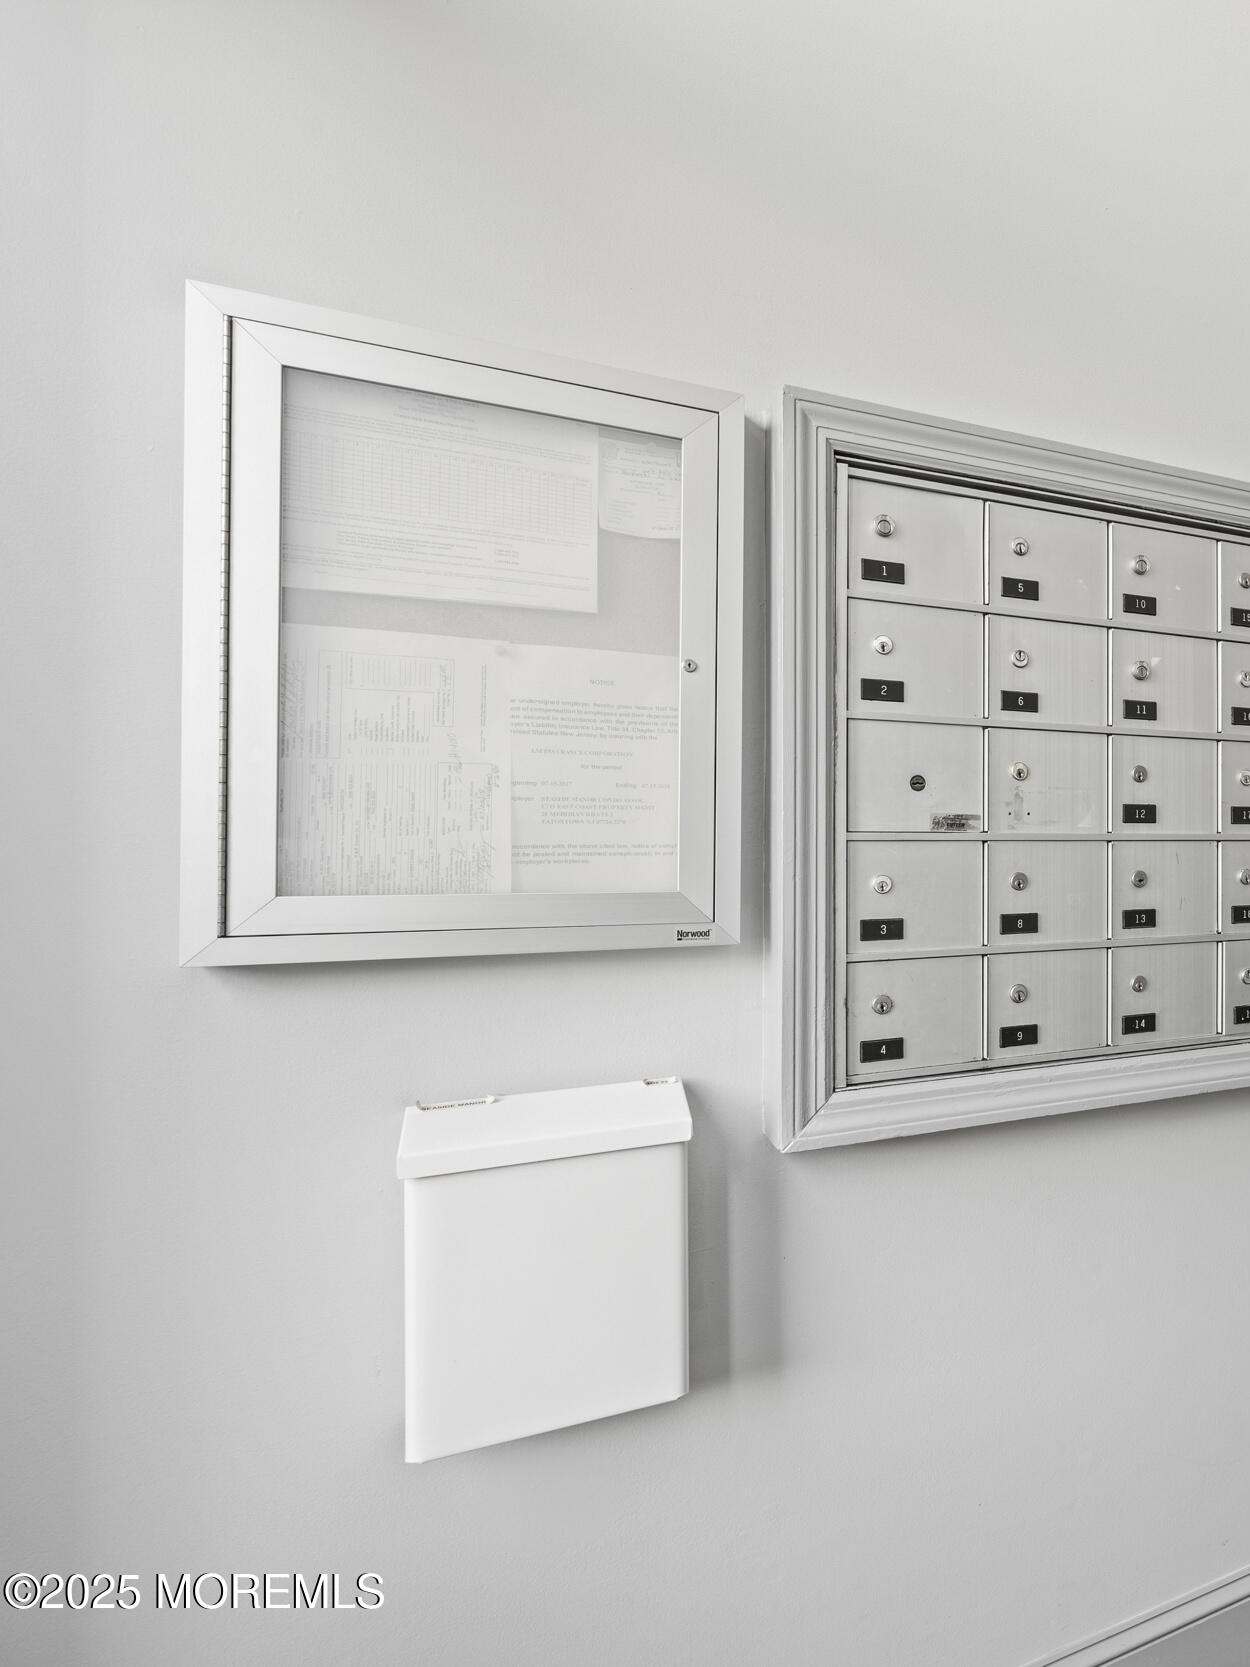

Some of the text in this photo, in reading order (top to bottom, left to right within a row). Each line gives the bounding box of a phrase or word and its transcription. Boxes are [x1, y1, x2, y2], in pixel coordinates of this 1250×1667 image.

[1018, 582, 1024, 593] 5
[1135, 599, 1146, 609] 10
[880, 684, 888, 696] 2
[1017, 696, 1024, 706] 6
[1136, 704, 1147, 715] 11
[1135, 809, 1146, 819] 12
[1017, 919, 1023, 929] 8
[1135, 914, 1146, 924] 13
[676, 929, 710, 938] Norwood
[880, 924, 887, 935] 3
[1135, 1018, 1146, 1029] 14
[1017, 1031, 1023, 1041] 9
[880, 1044, 887, 1055] 4
